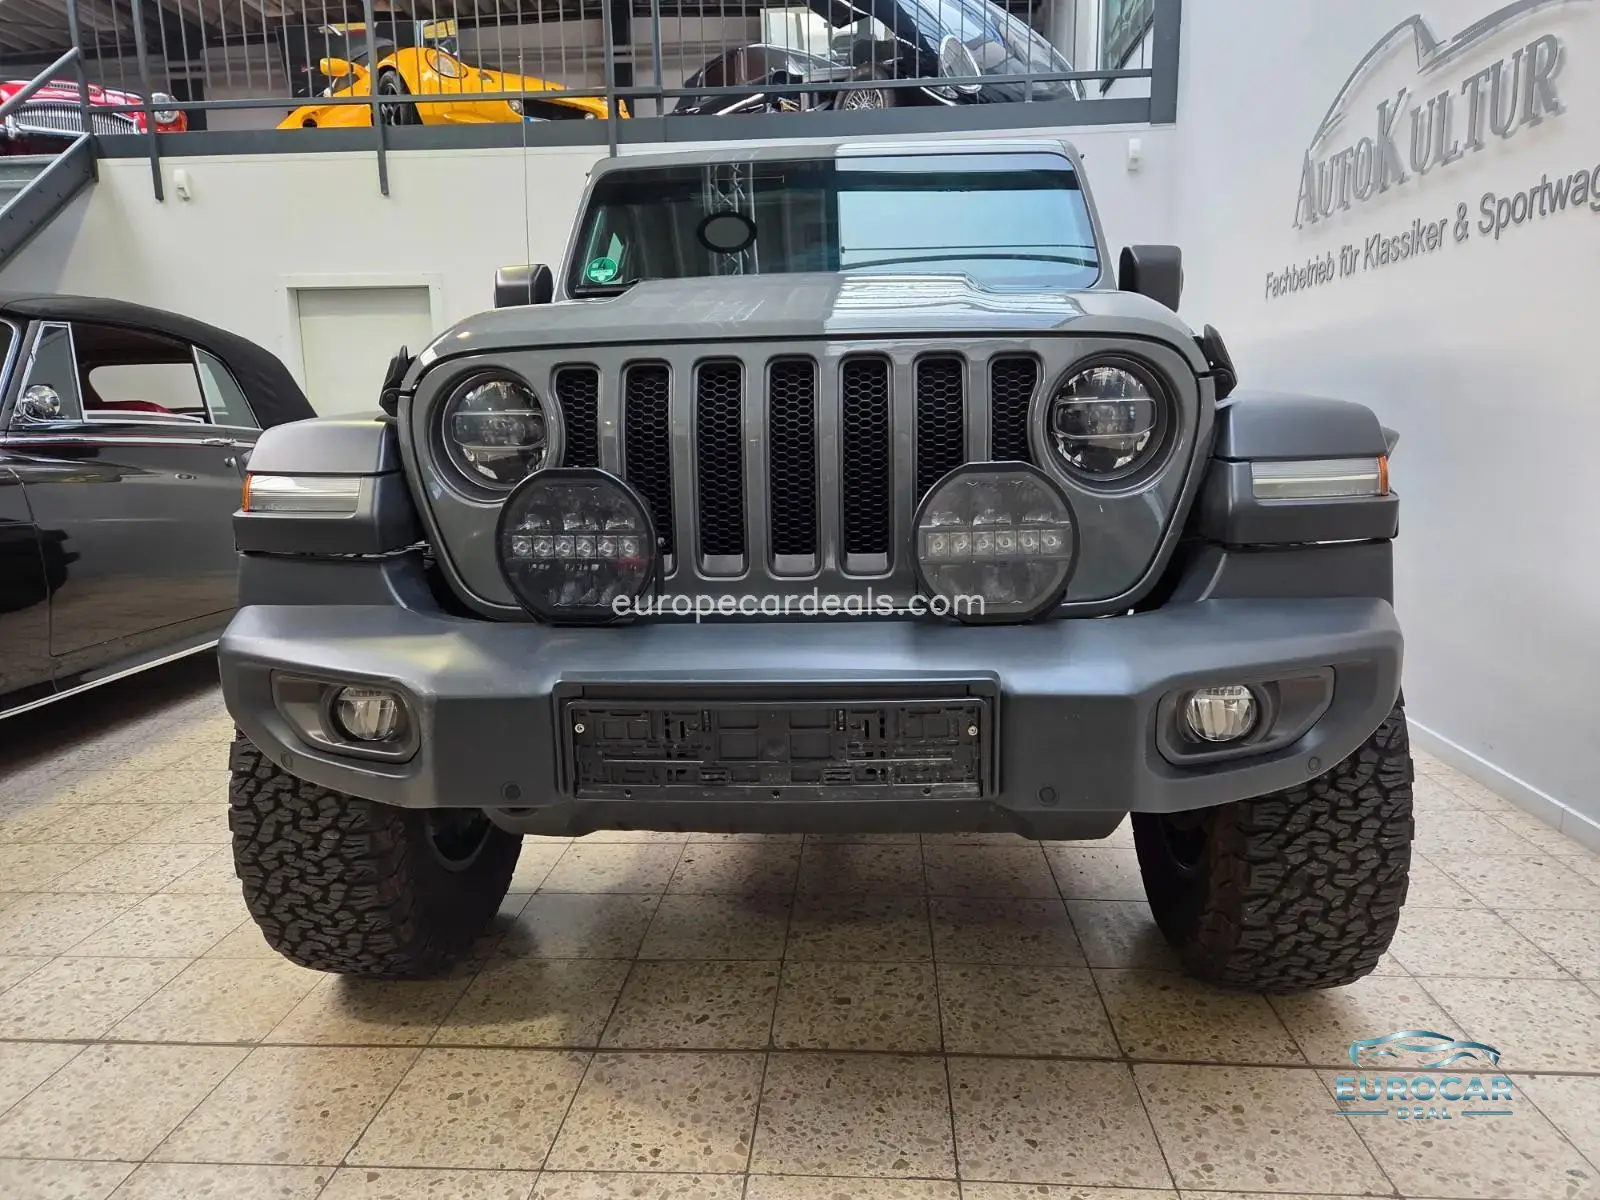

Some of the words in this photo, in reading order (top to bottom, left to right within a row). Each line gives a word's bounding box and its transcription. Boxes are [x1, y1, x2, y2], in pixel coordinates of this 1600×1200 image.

[1265, 251, 1335, 299] Fachbetrieb
[1339, 245, 1360, 279] für
[1363, 218, 1448, 270] Klassiker
[1453, 202, 1469, 242] &
